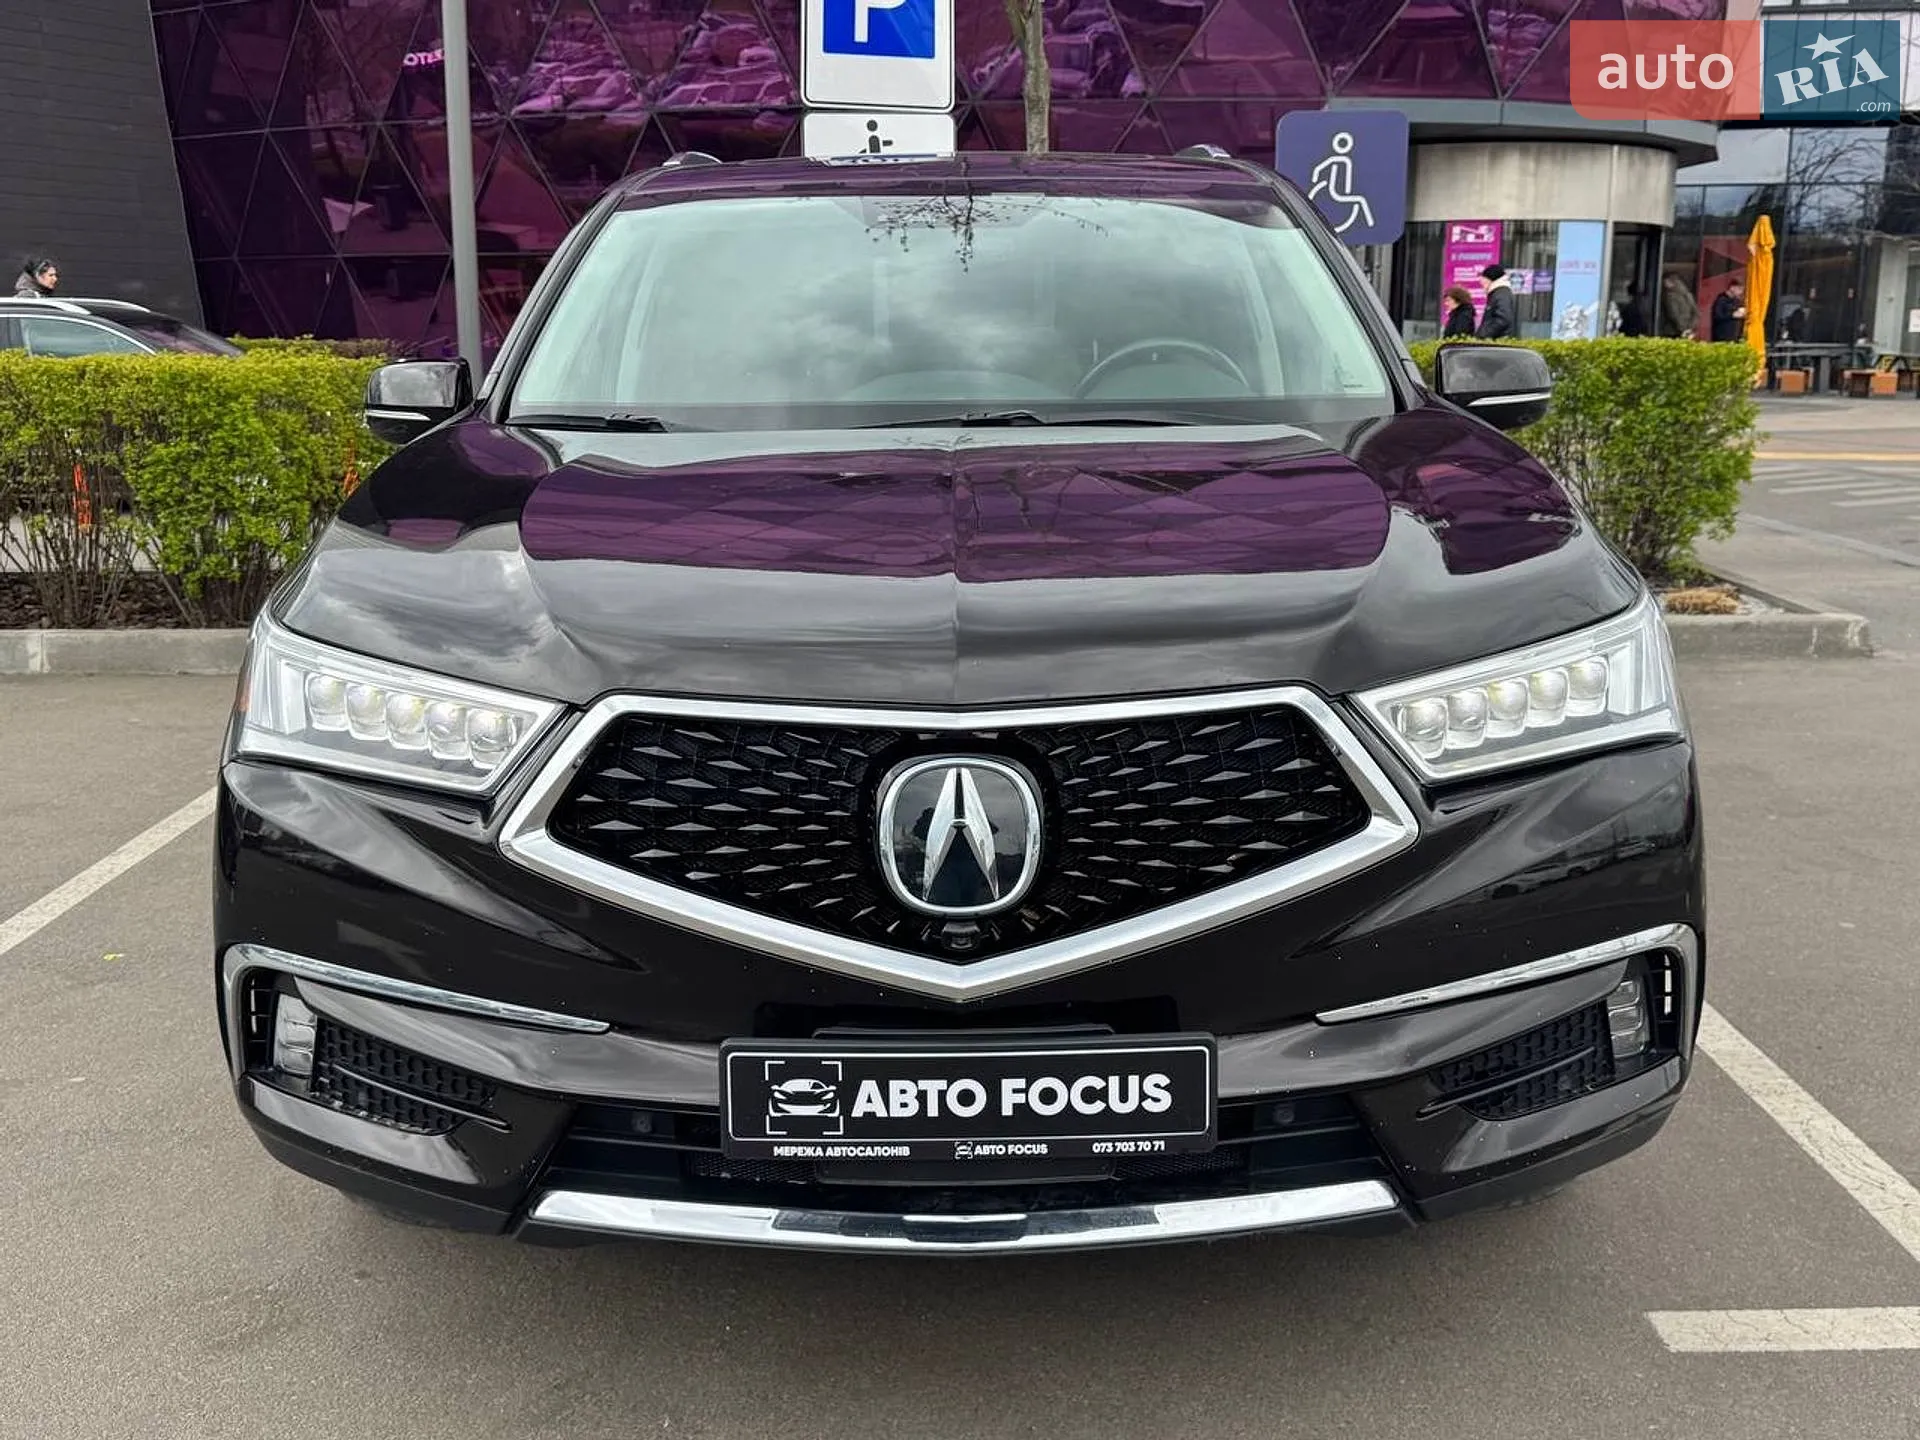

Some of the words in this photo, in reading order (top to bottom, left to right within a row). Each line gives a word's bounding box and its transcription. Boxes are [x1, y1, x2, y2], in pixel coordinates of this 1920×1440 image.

[850, 1078, 987, 1118] АВТО
[1001, 1073, 1173, 1117] FOCUS
[773, 1145, 824, 1157] МЕРЕЖА
[825, 1145, 911, 1157] АВТОСАЛОНІВ
[973, 1144, 1006, 1156] АВТО
[1008, 1143, 1048, 1155] FOCUS
[1092, 1142, 1113, 1153] 073
[1115, 1141, 1136, 1152] 703
[1137, 1140, 1151, 1151] 70
[1152, 1139, 1165, 1151] 71
